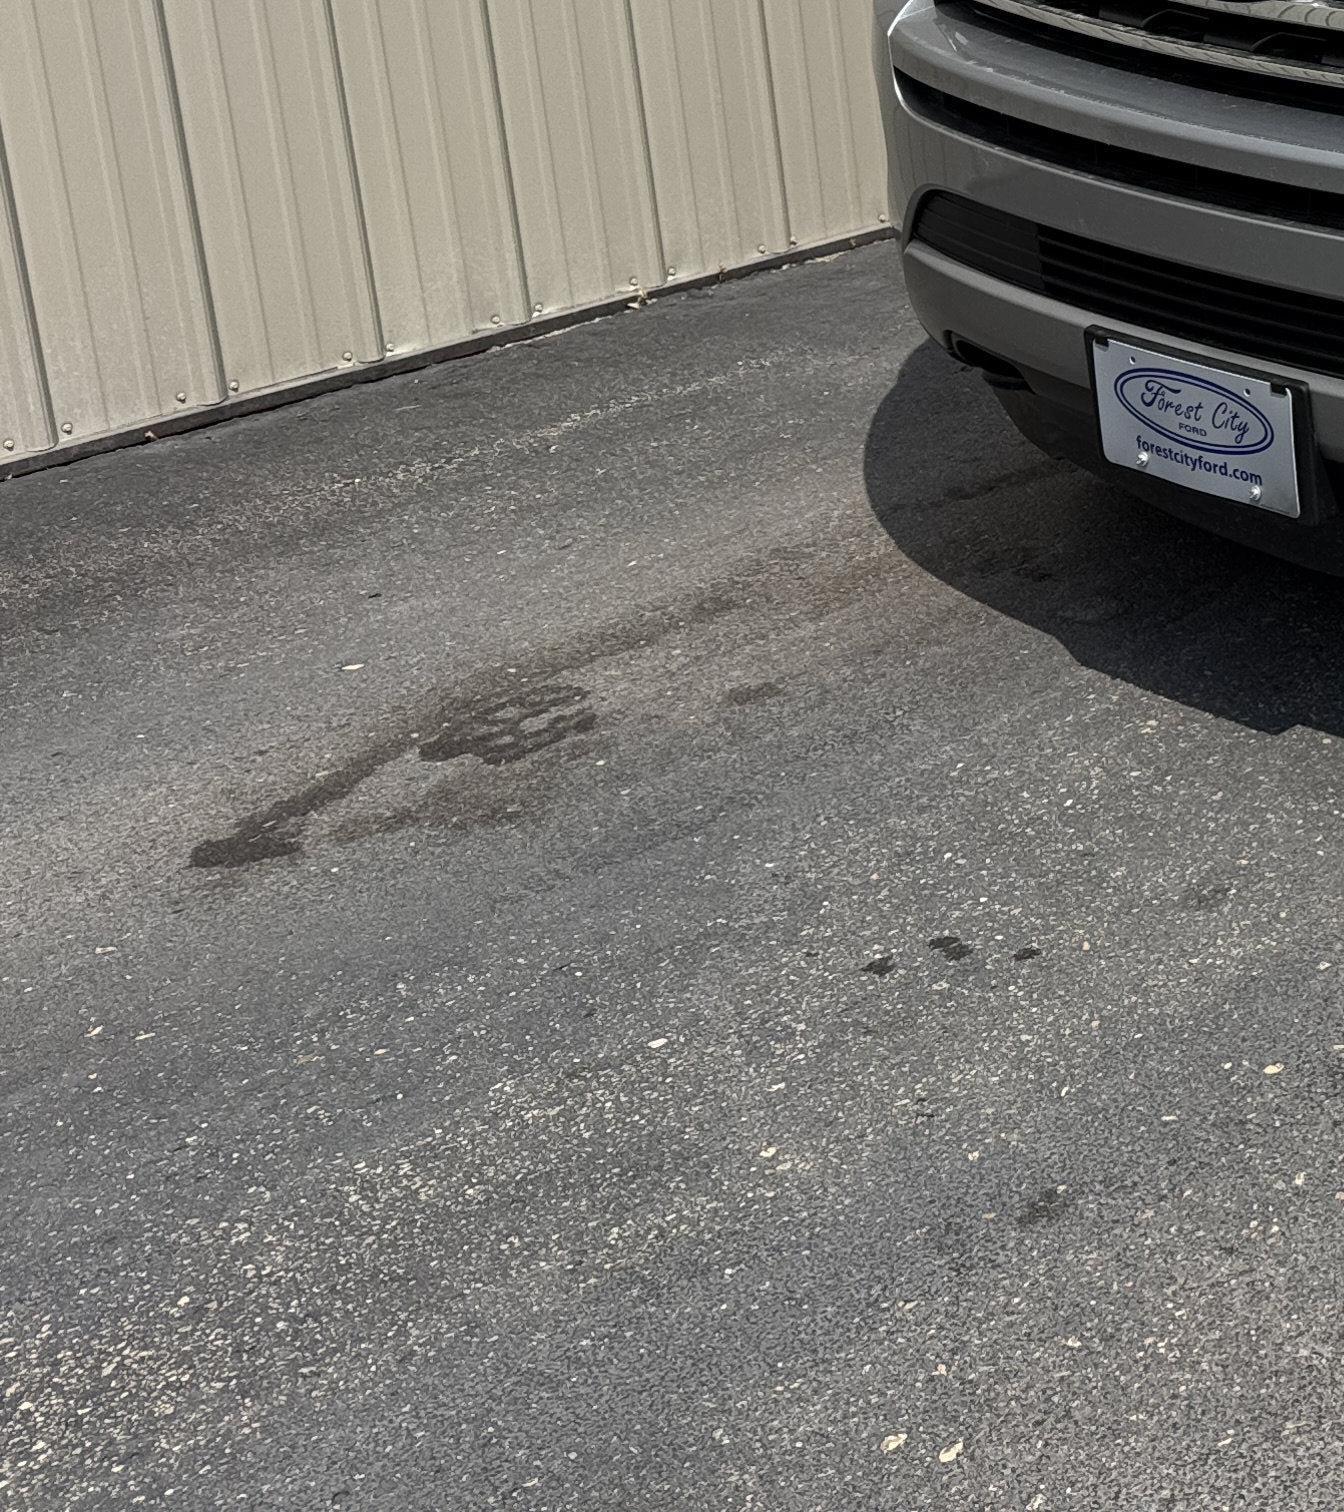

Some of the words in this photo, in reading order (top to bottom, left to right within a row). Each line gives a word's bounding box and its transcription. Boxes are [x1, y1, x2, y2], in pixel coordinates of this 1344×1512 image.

[1140, 379, 1204, 422] Forest
[1211, 401, 1250, 444] City
[1178, 422, 1207, 437] FORD
[1135, 435, 1263, 486] forestcityford.com
